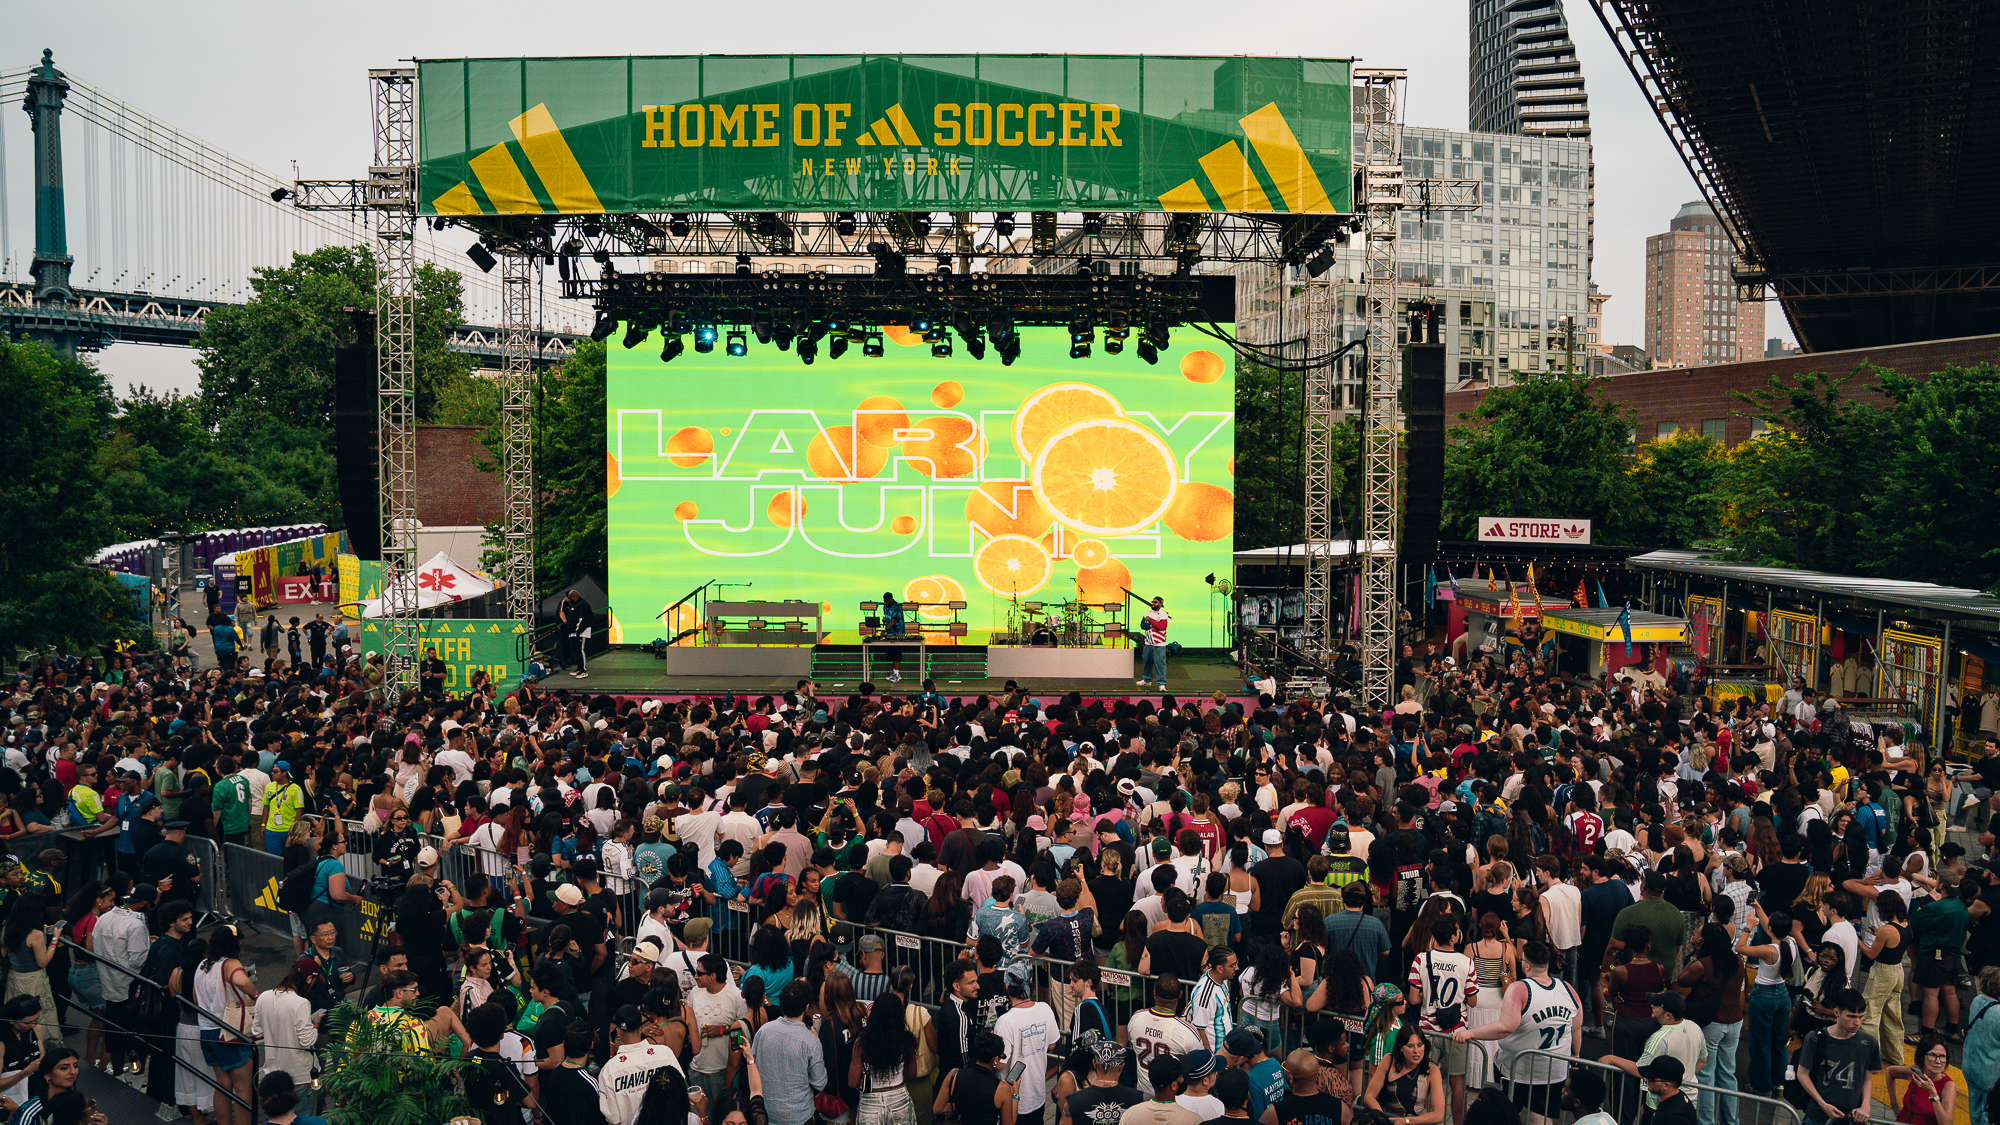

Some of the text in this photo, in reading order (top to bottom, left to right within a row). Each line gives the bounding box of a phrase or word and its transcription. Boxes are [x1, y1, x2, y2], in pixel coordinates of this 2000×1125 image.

[641, 102, 1123, 148] HOME OF SOCCER
[802, 157, 961, 176] NEW YORK
[682, 484, 1163, 558] JUN
[1509, 522, 1560, 539] STORE
[285, 582, 332, 599] EXT
[1463, 597, 1491, 613] NEWS NEWS
[1554, 617, 1591, 635] NEWS NEWS
[419, 637, 471, 661] FIFA
[236, 783, 245, 803] 6
[1585, 825, 1596, 845] 2
[1400, 869, 1420, 880] TOUR
[1069, 919, 1079, 929] 10
[1101, 971, 1130, 982] NATIONAL
[1432, 962, 1458, 973] PULISIC
[1531, 1005, 1572, 1024] GARNETT
[1537, 1023, 1567, 1050] 21
[1271, 1069, 1282, 1080] THIS
[1820, 1059, 1856, 1090] 74
